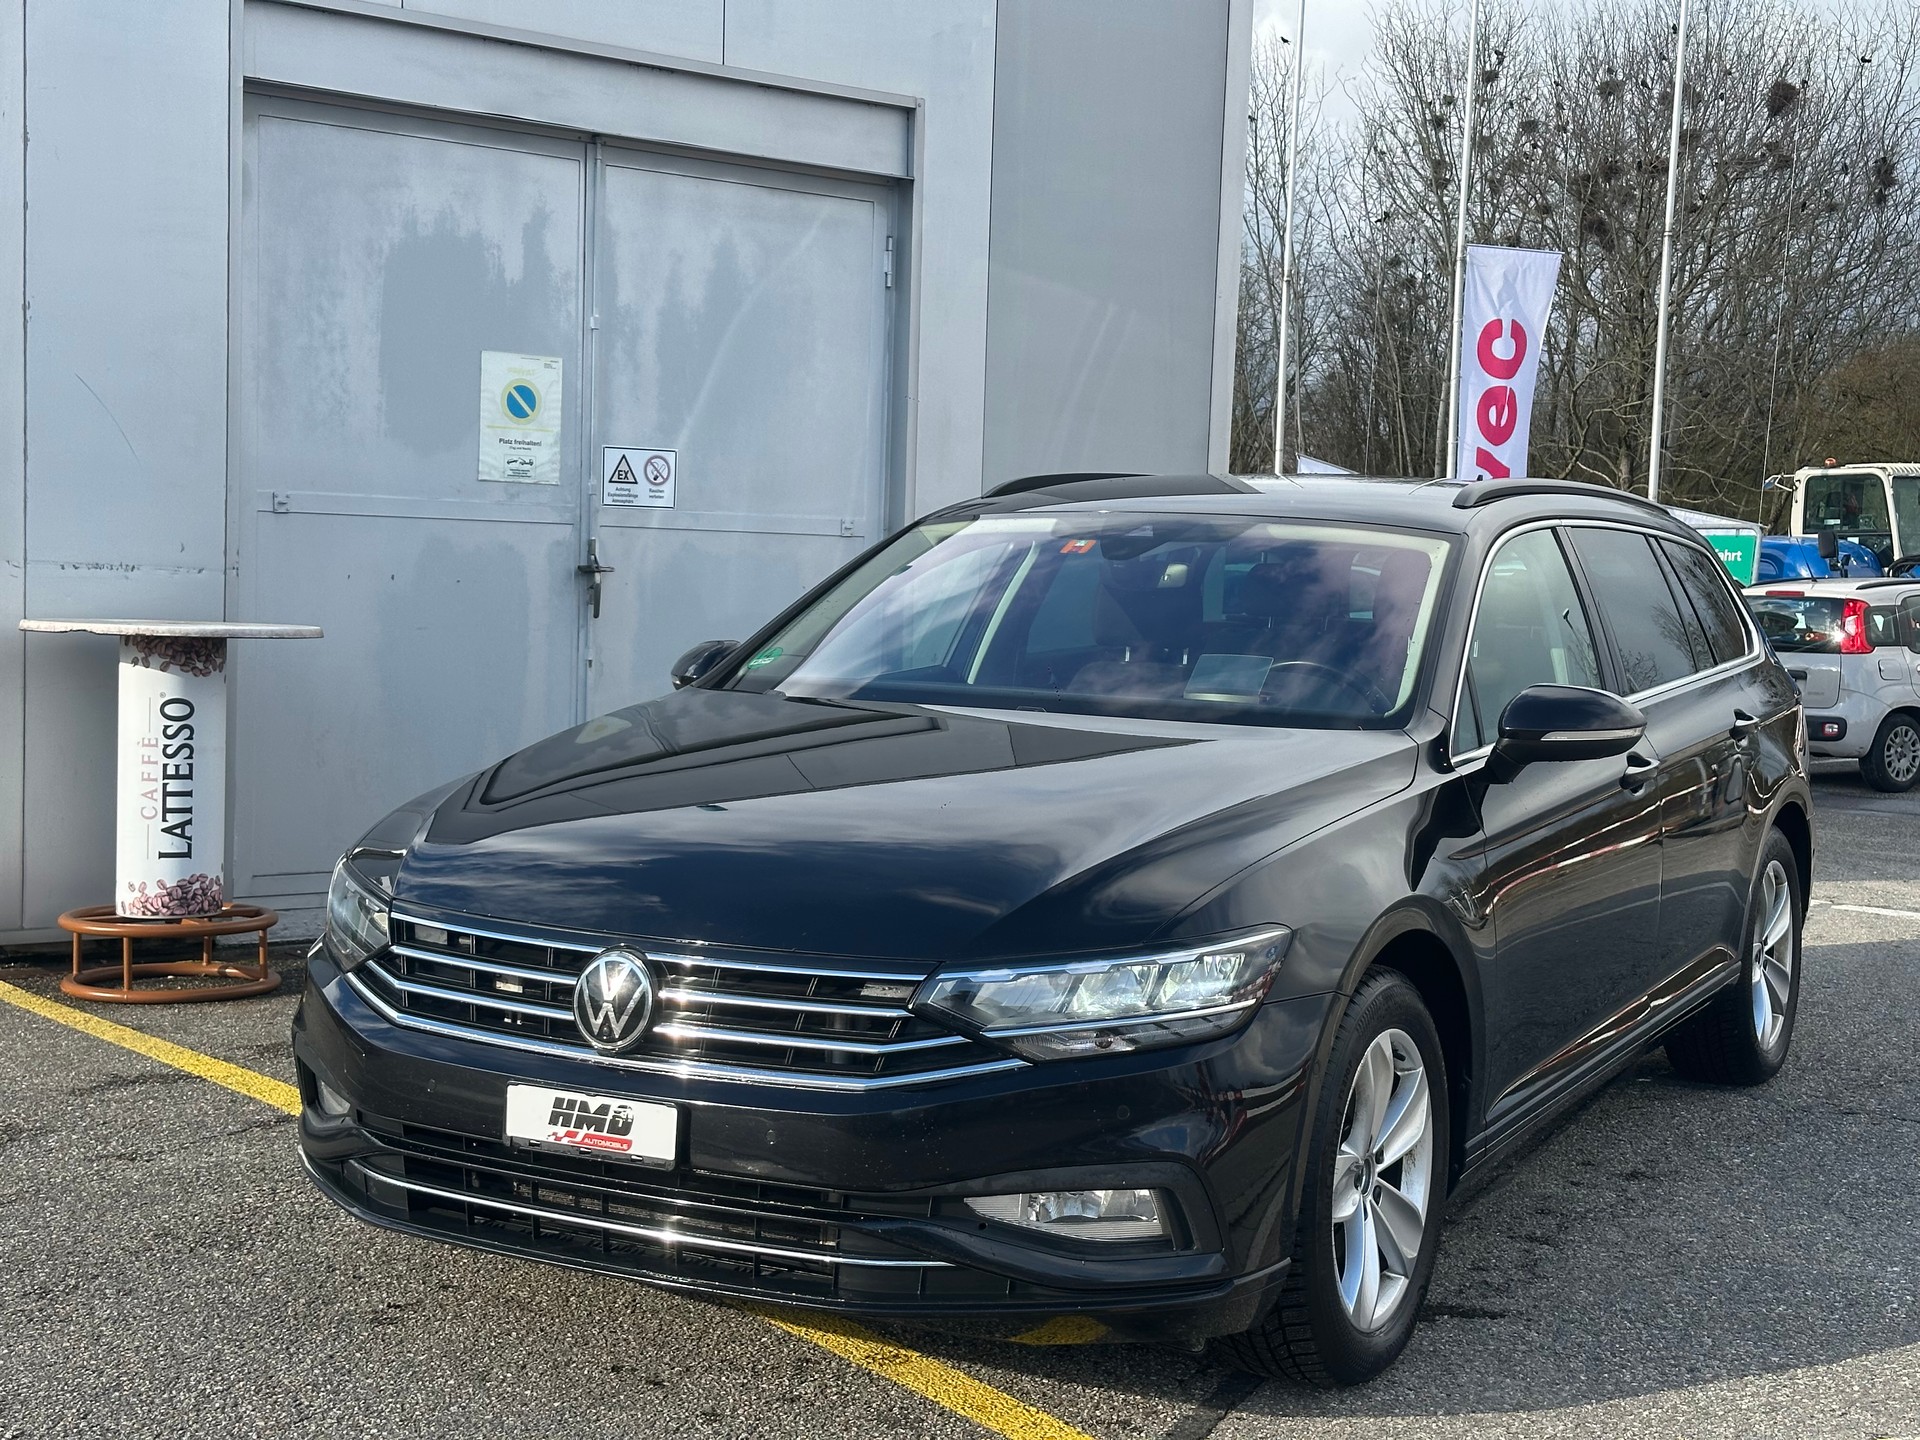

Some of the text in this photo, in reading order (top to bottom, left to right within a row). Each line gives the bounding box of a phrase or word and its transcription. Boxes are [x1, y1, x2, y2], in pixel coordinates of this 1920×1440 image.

[617, 469, 630, 481] EX
[1714, 548, 1743, 562] ahrt
[136, 736, 159, 820] CAFFÈ
[158, 697, 195, 860] LATTESSO
[583, 1137, 630, 1150] AUTOMOBILE
